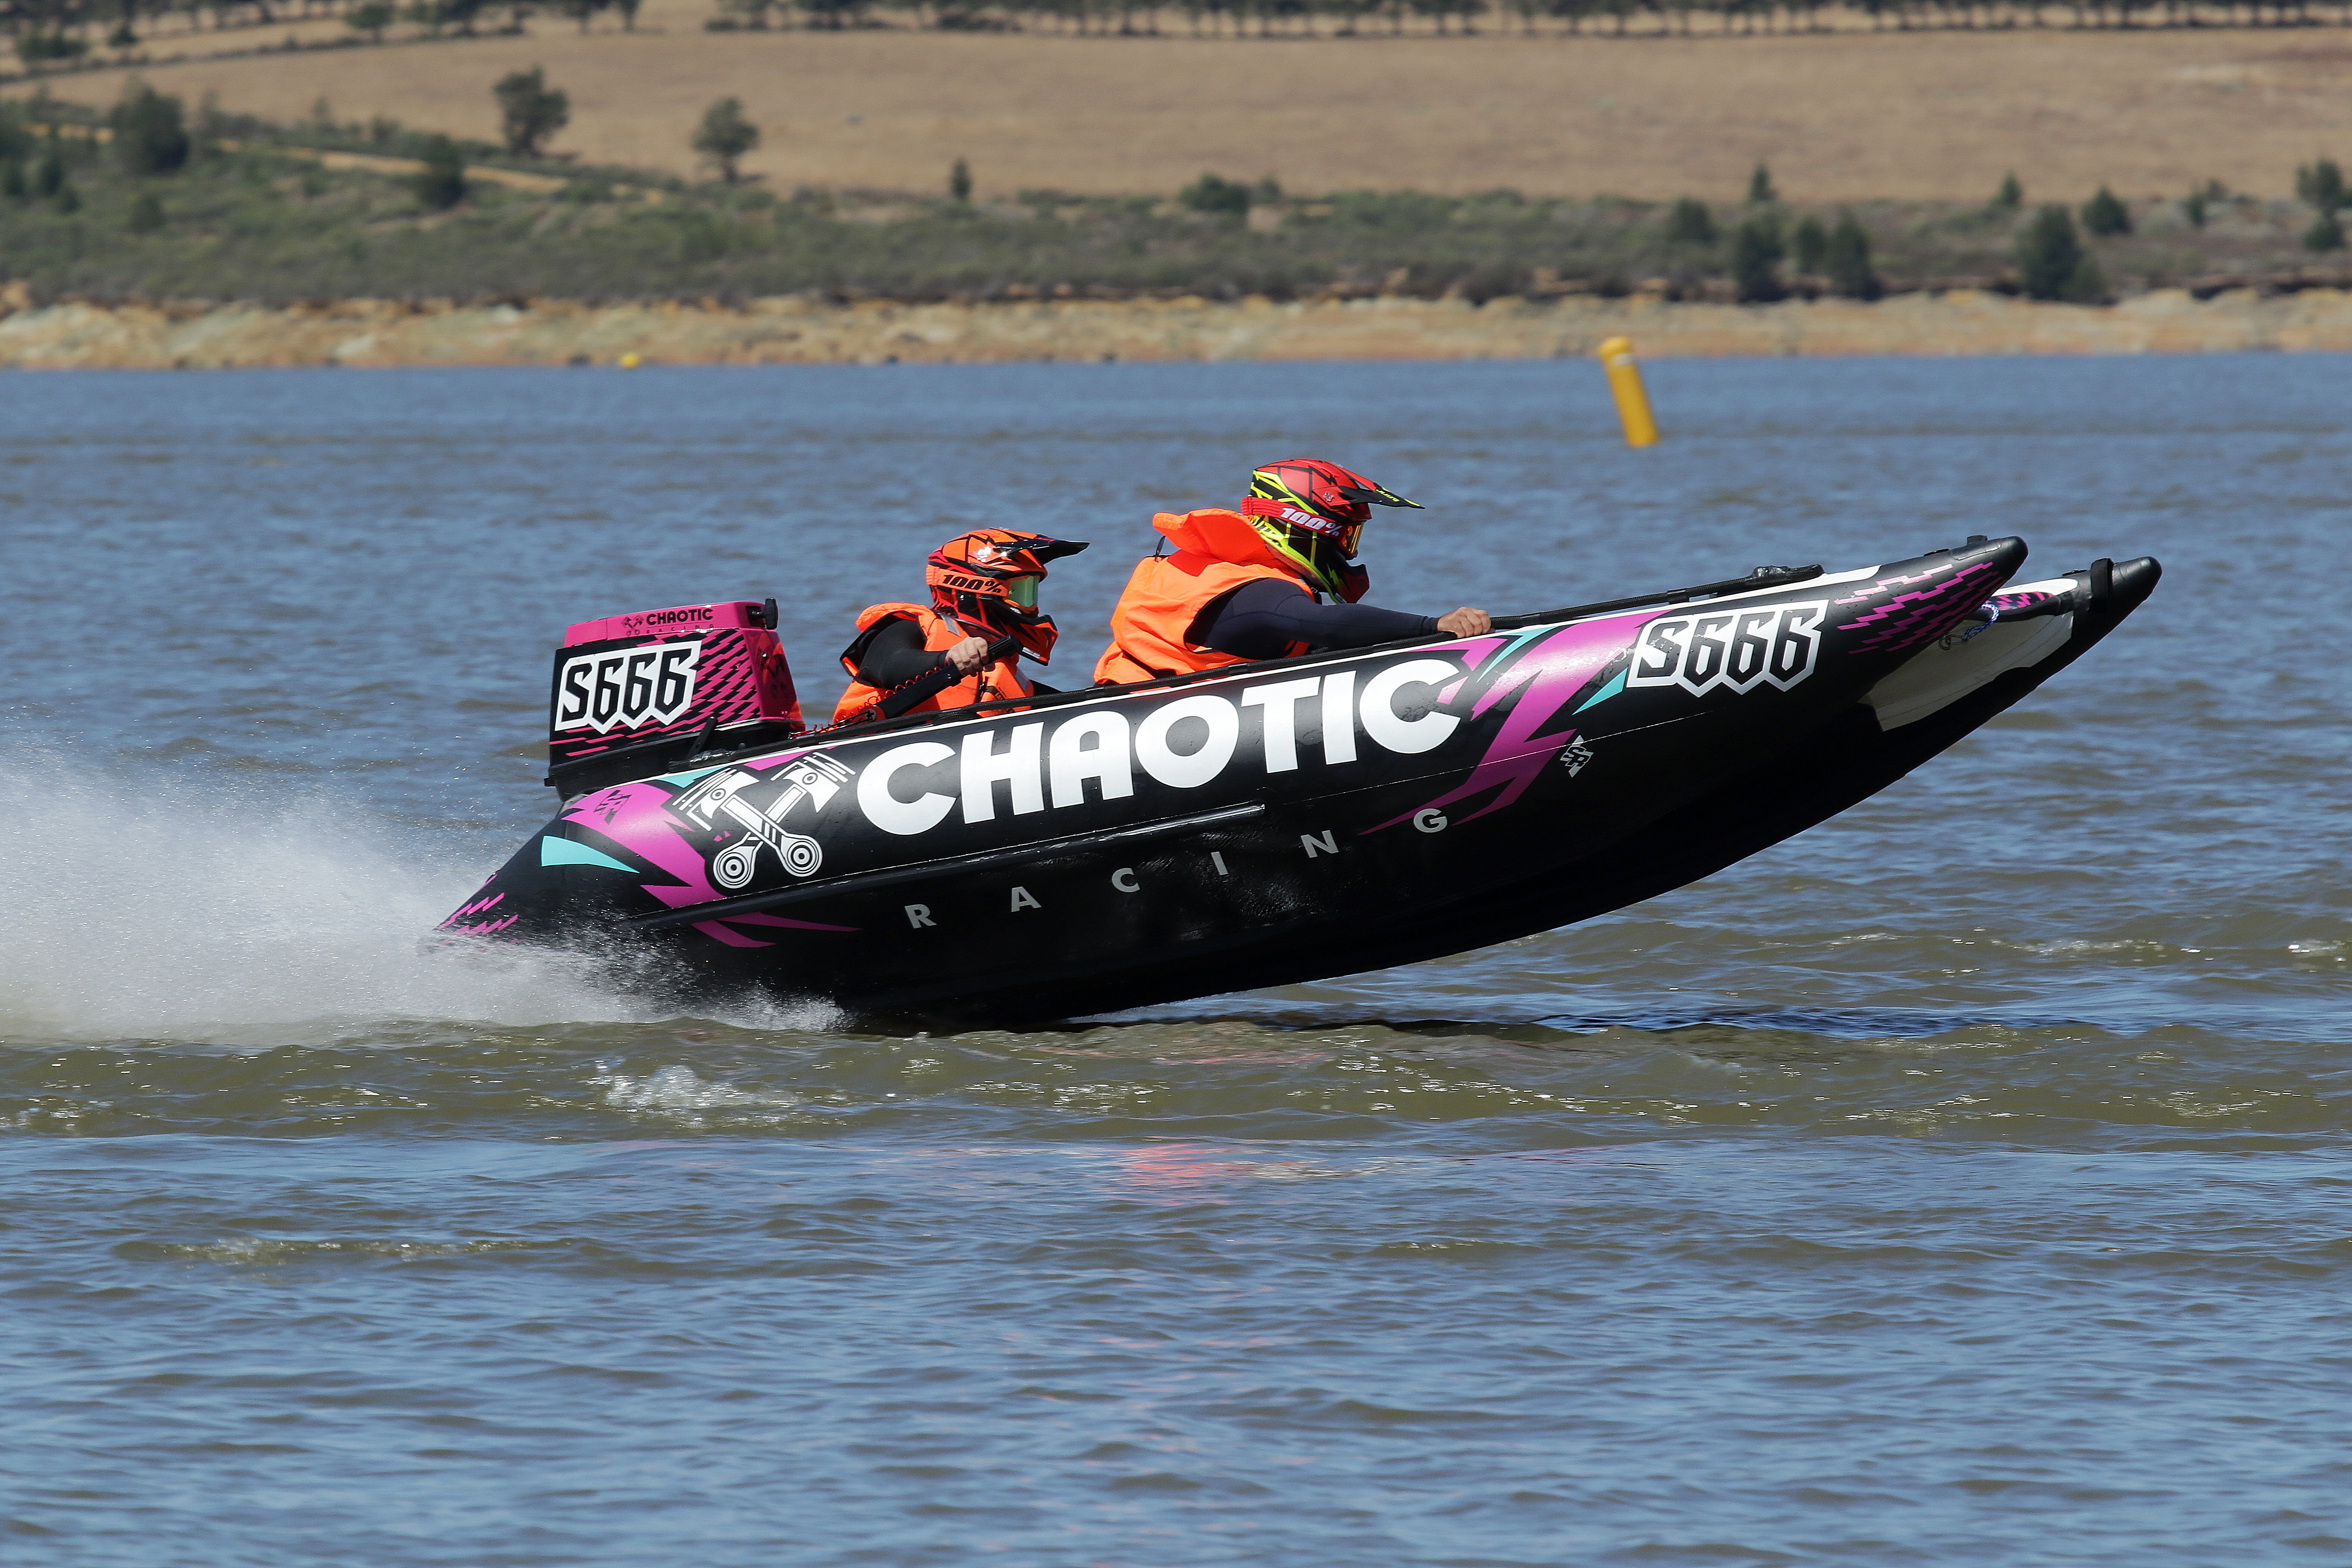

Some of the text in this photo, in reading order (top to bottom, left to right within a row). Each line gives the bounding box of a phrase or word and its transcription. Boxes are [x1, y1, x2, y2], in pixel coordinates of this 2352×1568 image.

[1280, 507, 1343, 536] 100%
[647, 609, 714, 625] CHAOTIC
[943, 575, 1003, 593] 100%
[560, 647, 694, 726] S666
[1638, 609, 1816, 687] S666
[857, 658, 1461, 835] CHAOTIC
[905, 808, 1448, 928] RACING
